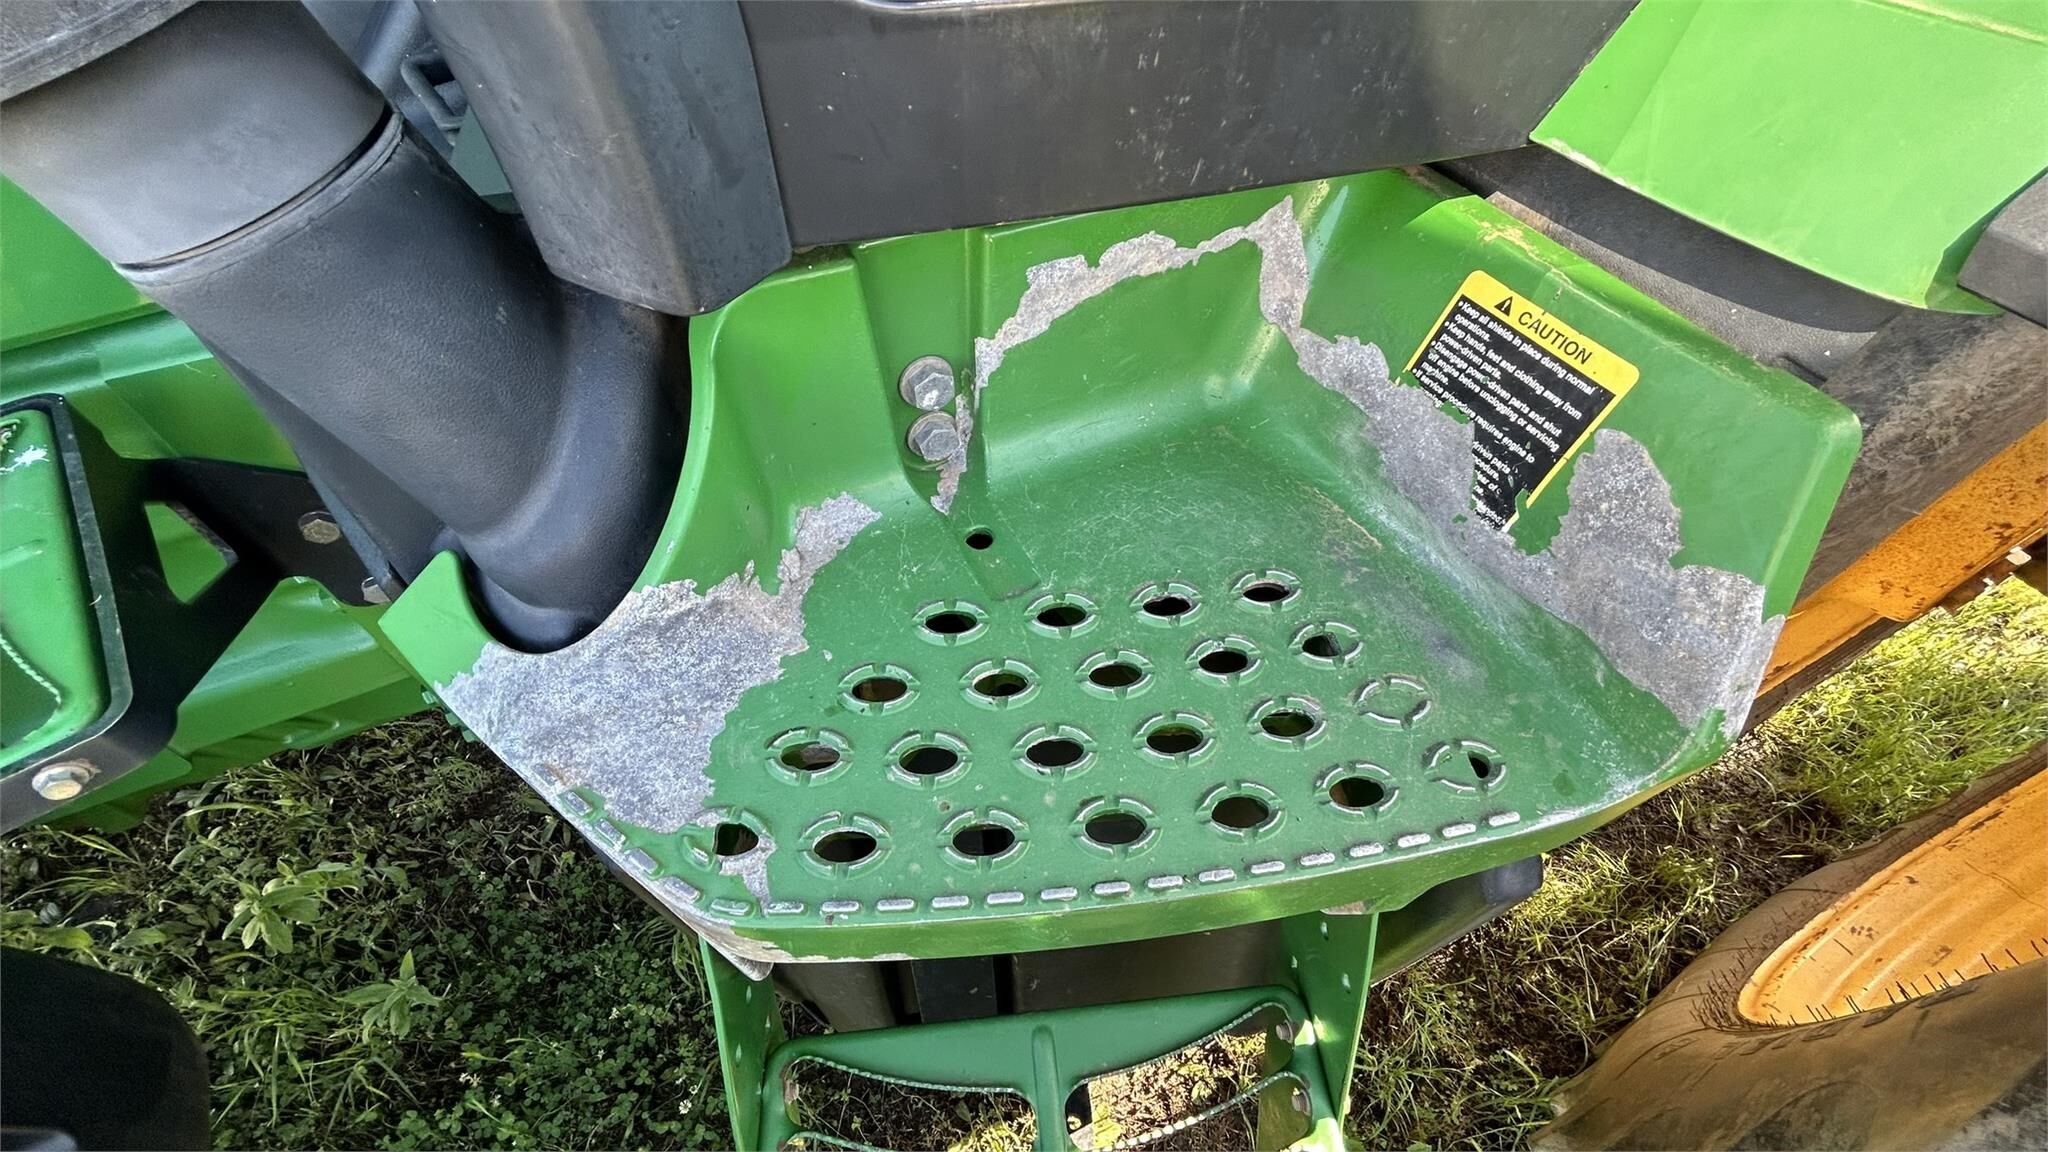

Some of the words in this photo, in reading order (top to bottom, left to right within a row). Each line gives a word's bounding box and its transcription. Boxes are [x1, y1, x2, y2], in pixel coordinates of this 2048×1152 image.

[1439, 332, 1482, 365] power-driven
[1479, 361, 1501, 379] parts.
[1454, 313, 1490, 342] operations.
[1460, 301, 1480, 319] Keep
[1477, 314, 1490, 324] all
[1487, 320, 1514, 341] shields
[1511, 335, 1522, 346] in
[1518, 342, 1542, 360] place
[1539, 356, 1567, 378] during
[1564, 372, 1596, 395] normal
[1518, 311, 1592, 364] CAUTION
[1427, 349, 1439, 362] off
[1436, 358, 1459, 377] engine
[1457, 372, 1480, 392] before
[1479, 389, 1518, 422] unclogging
[1516, 417, 1527, 426] or
[1525, 423, 1559, 452] servicing
[1431, 341, 1468, 369] Disengage
[1507, 396, 1530, 413] parts
[1527, 410, 1545, 424] and
[1542, 421, 1562, 437] shut
[1447, 321, 1465, 339] Keep
[1463, 333, 1486, 355] hands,
[1485, 348, 1502, 363] feet
[1498, 359, 1517, 373] and
[1513, 369, 1544, 394] clothing
[1542, 389, 1564, 407] away
[1561, 401, 1582, 419] from
[1414, 369, 1423, 377] If
[1420, 374, 1443, 393] service
[1472, 415, 1503, 439] requires
[1500, 436, 1526, 457] engine
[1524, 452, 1535, 463] to
[1487, 482, 1498, 491] of
[1489, 456, 1513, 474] parts
